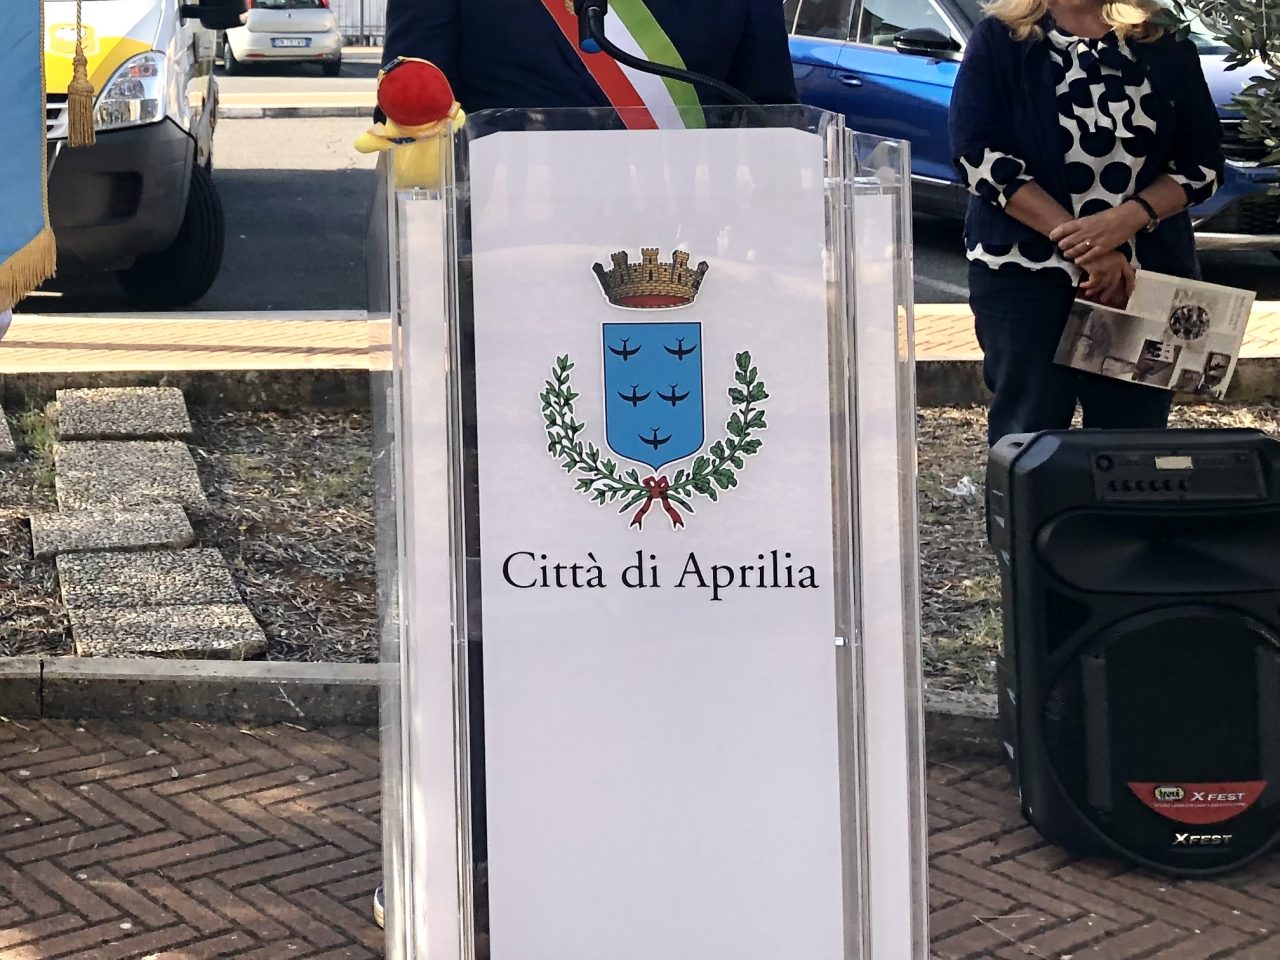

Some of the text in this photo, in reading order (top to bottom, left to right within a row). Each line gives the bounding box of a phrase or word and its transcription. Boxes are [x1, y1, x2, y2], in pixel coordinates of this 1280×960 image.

[502, 549, 820, 602] Città di Aprilia
